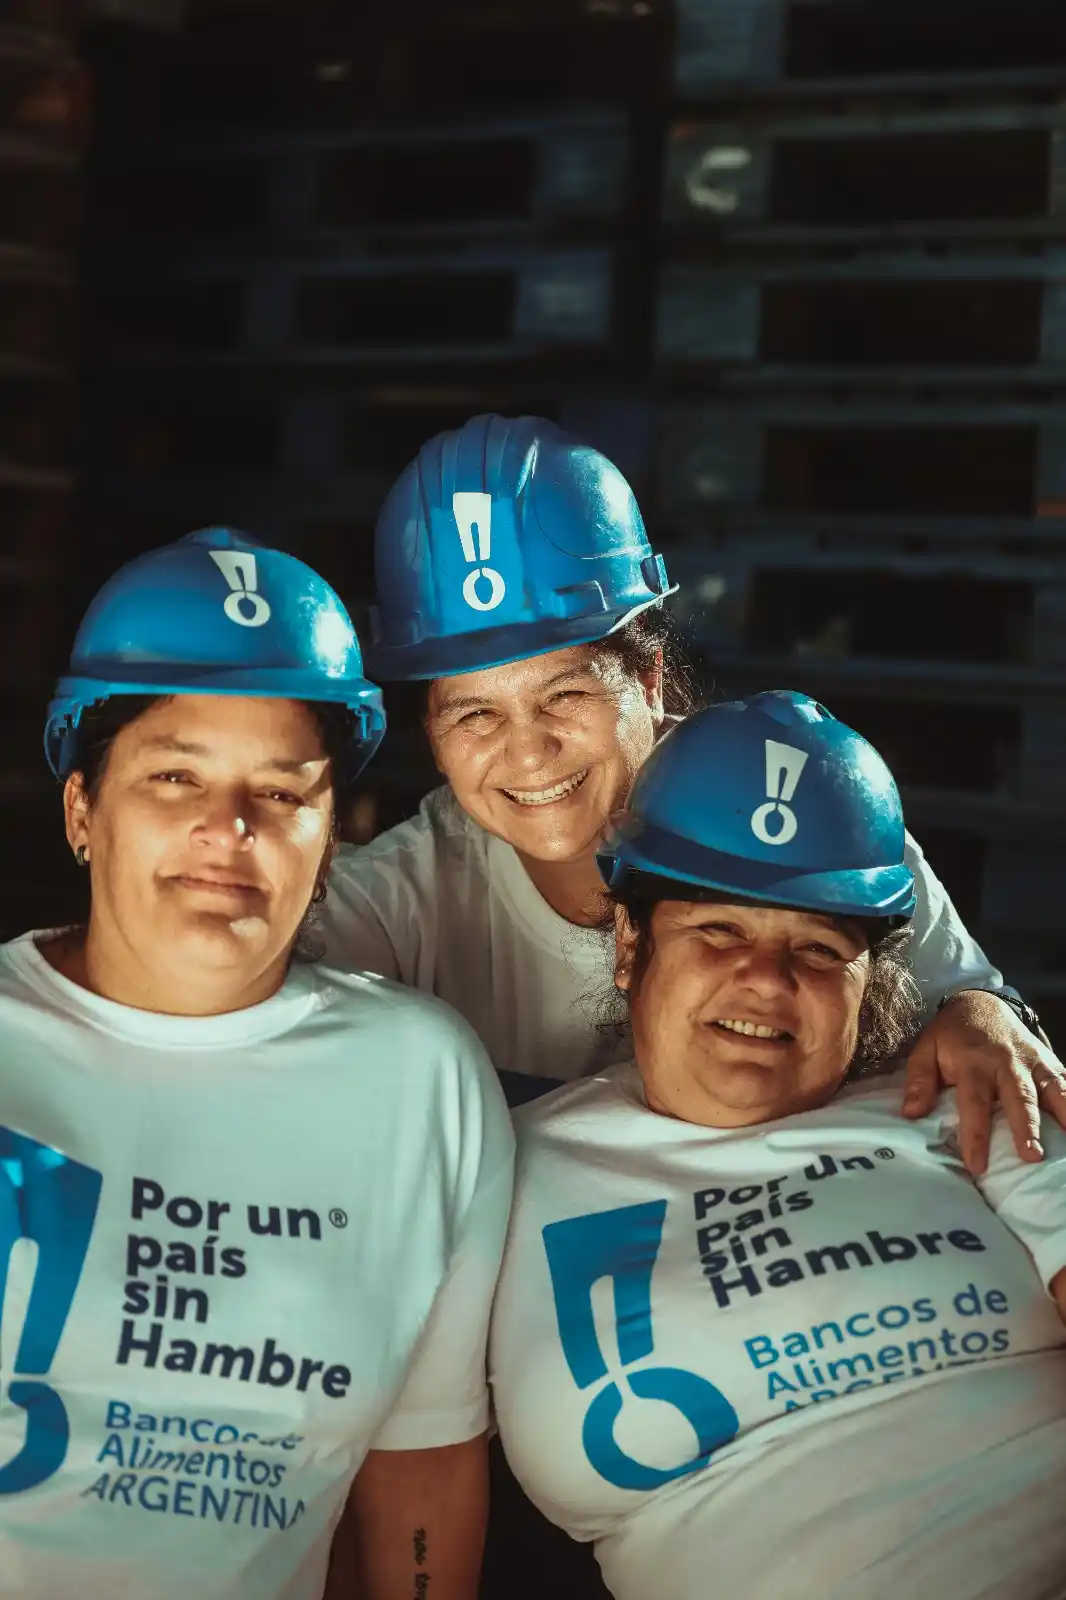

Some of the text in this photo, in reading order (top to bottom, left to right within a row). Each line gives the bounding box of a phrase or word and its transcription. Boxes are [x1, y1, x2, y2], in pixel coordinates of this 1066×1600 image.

[130, 1176, 230, 1231] Por
[693, 1175, 788, 1221] Por
[696, 1189, 814, 1254] país
[126, 1234, 247, 1278] país
[700, 1224, 793, 1277] sin
[709, 1228, 988, 1308] Hambre
[121, 1275, 210, 1323] sin
[744, 1283, 1010, 1369] Bancos de
[115, 1319, 352, 1398] Hambre
[766, 1327, 1010, 1400] Alimentos
[96, 1433, 287, 1488] Alimentos
